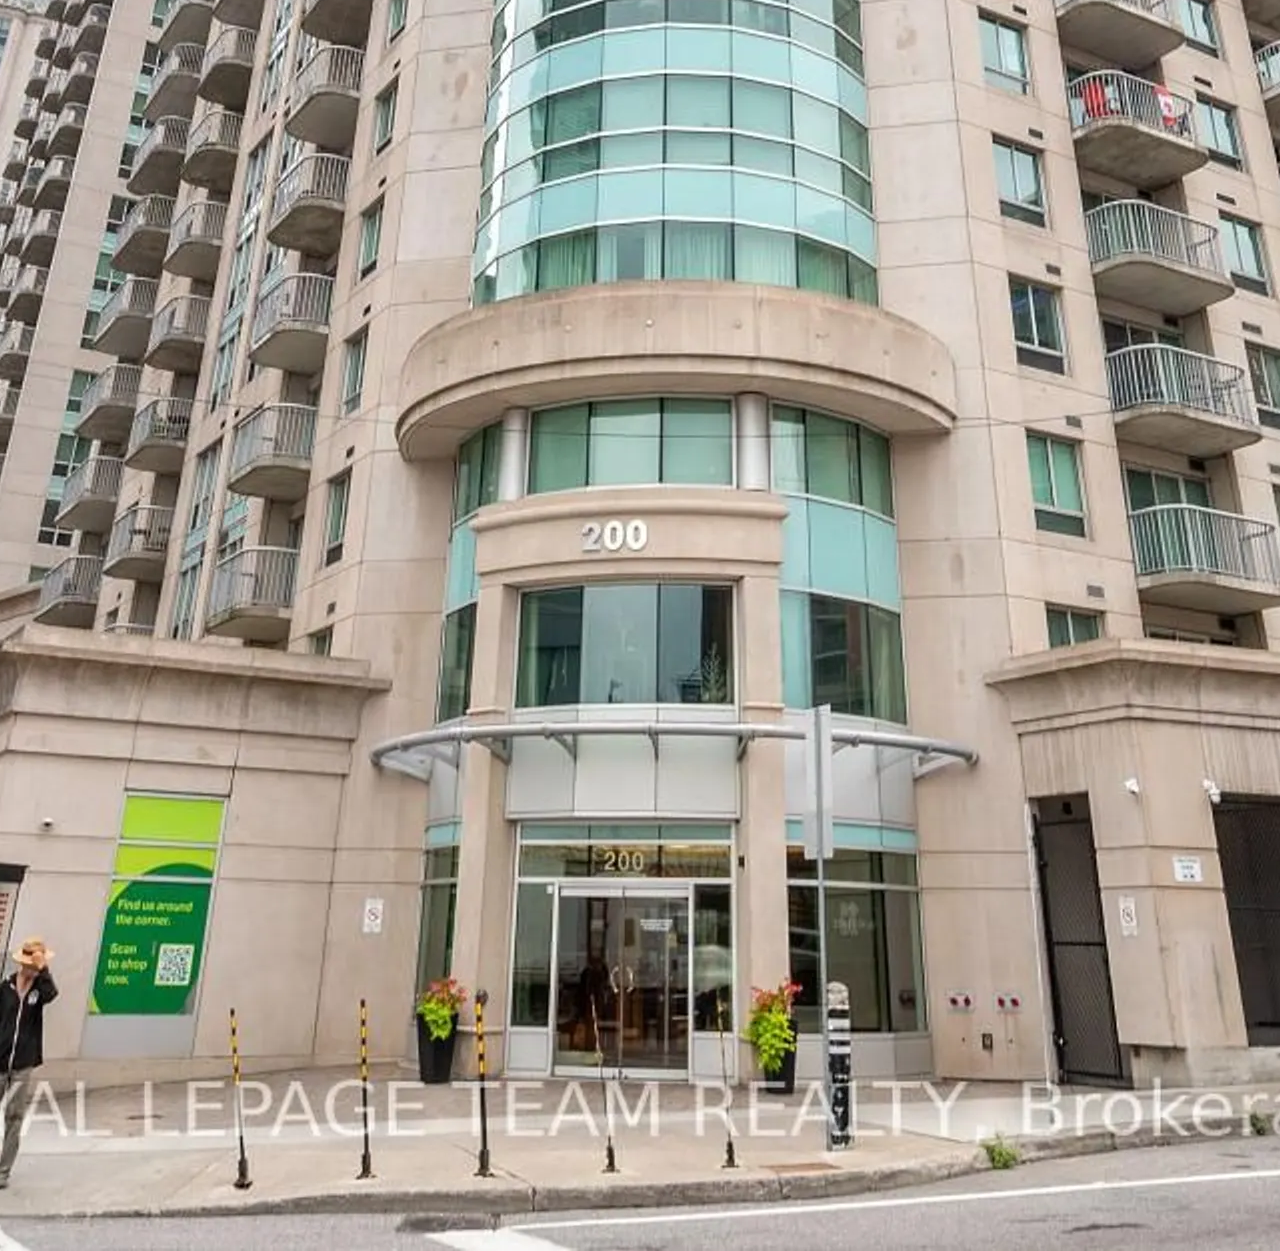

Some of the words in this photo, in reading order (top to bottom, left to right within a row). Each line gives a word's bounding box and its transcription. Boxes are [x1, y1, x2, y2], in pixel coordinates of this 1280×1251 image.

[581, 518, 648, 551] 200
[604, 851, 644, 871] 200
[117, 899, 141, 911] Find
[142, 901, 155, 911] us
[156, 901, 193, 913] around
[116, 914, 133, 925] the
[110, 943, 138, 955] Scan
[108, 959, 119, 970] to
[121, 959, 148, 972] shop
